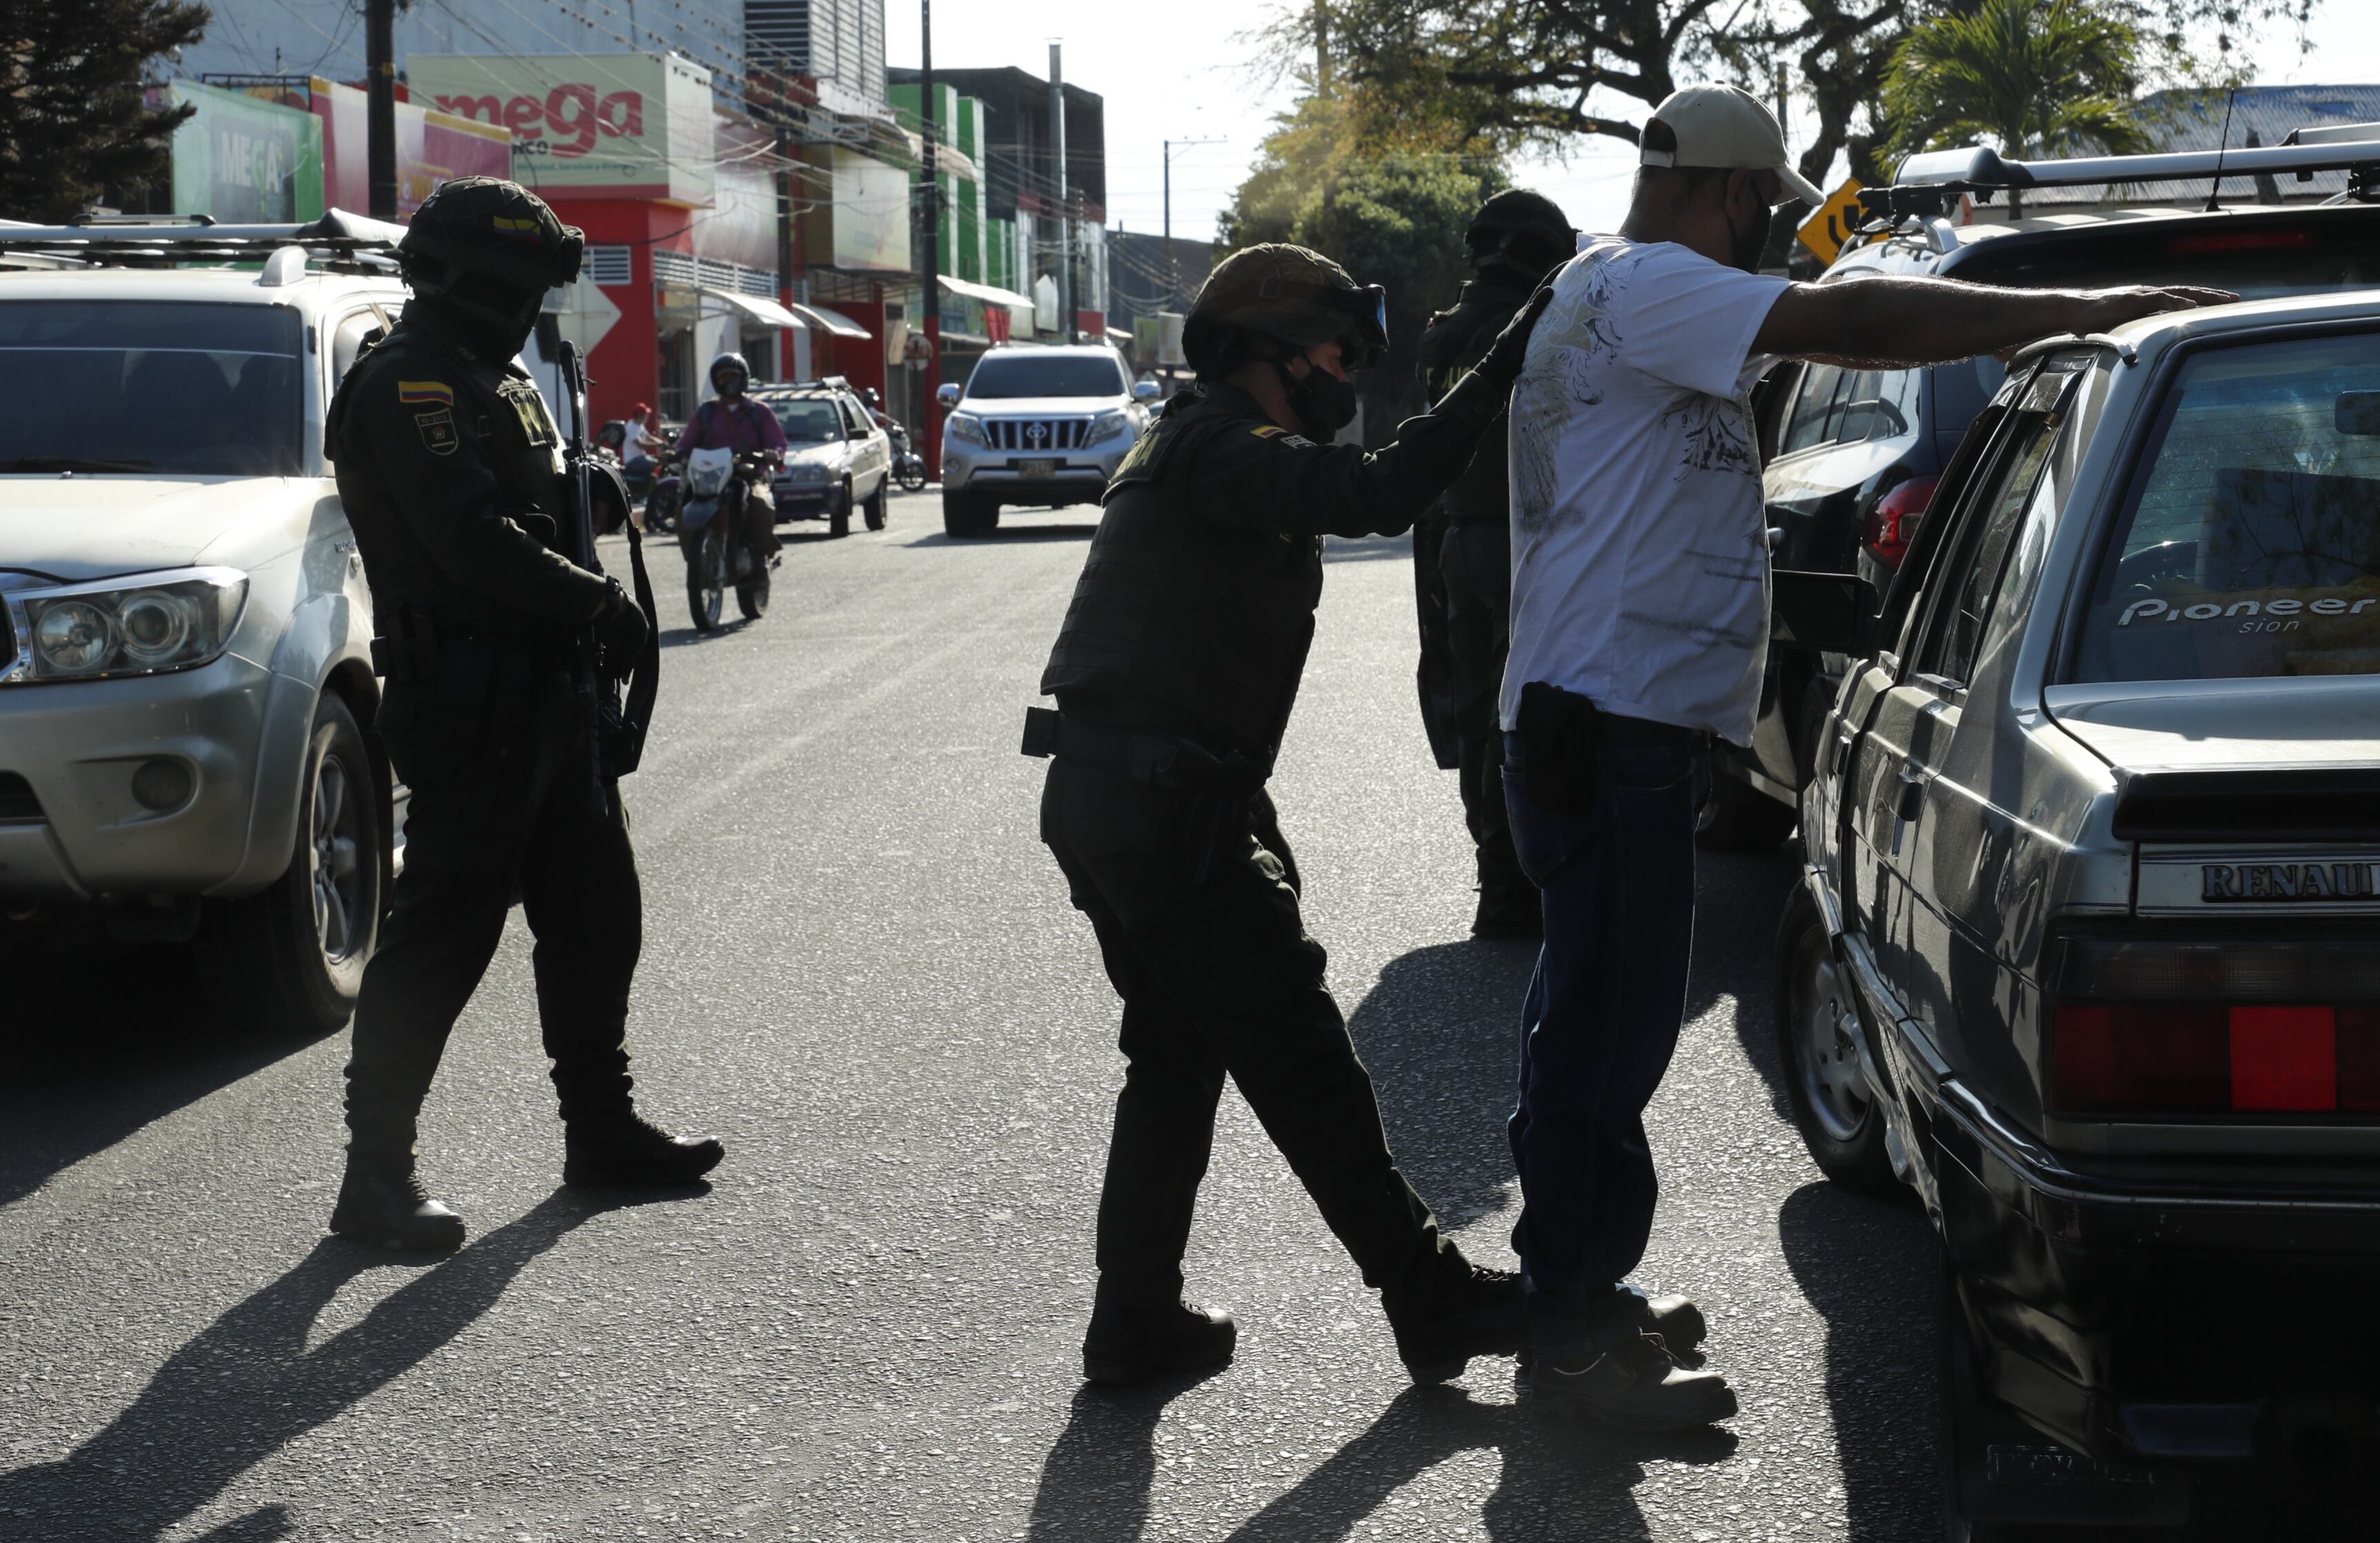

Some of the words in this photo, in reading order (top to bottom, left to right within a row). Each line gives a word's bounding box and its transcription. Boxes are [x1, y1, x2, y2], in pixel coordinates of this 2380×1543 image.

[434, 83, 644, 158] mega
[221, 131, 280, 194] MEGA
[2117, 598, 2377, 626] Pioneer
[2239, 618, 2299, 634] sion
